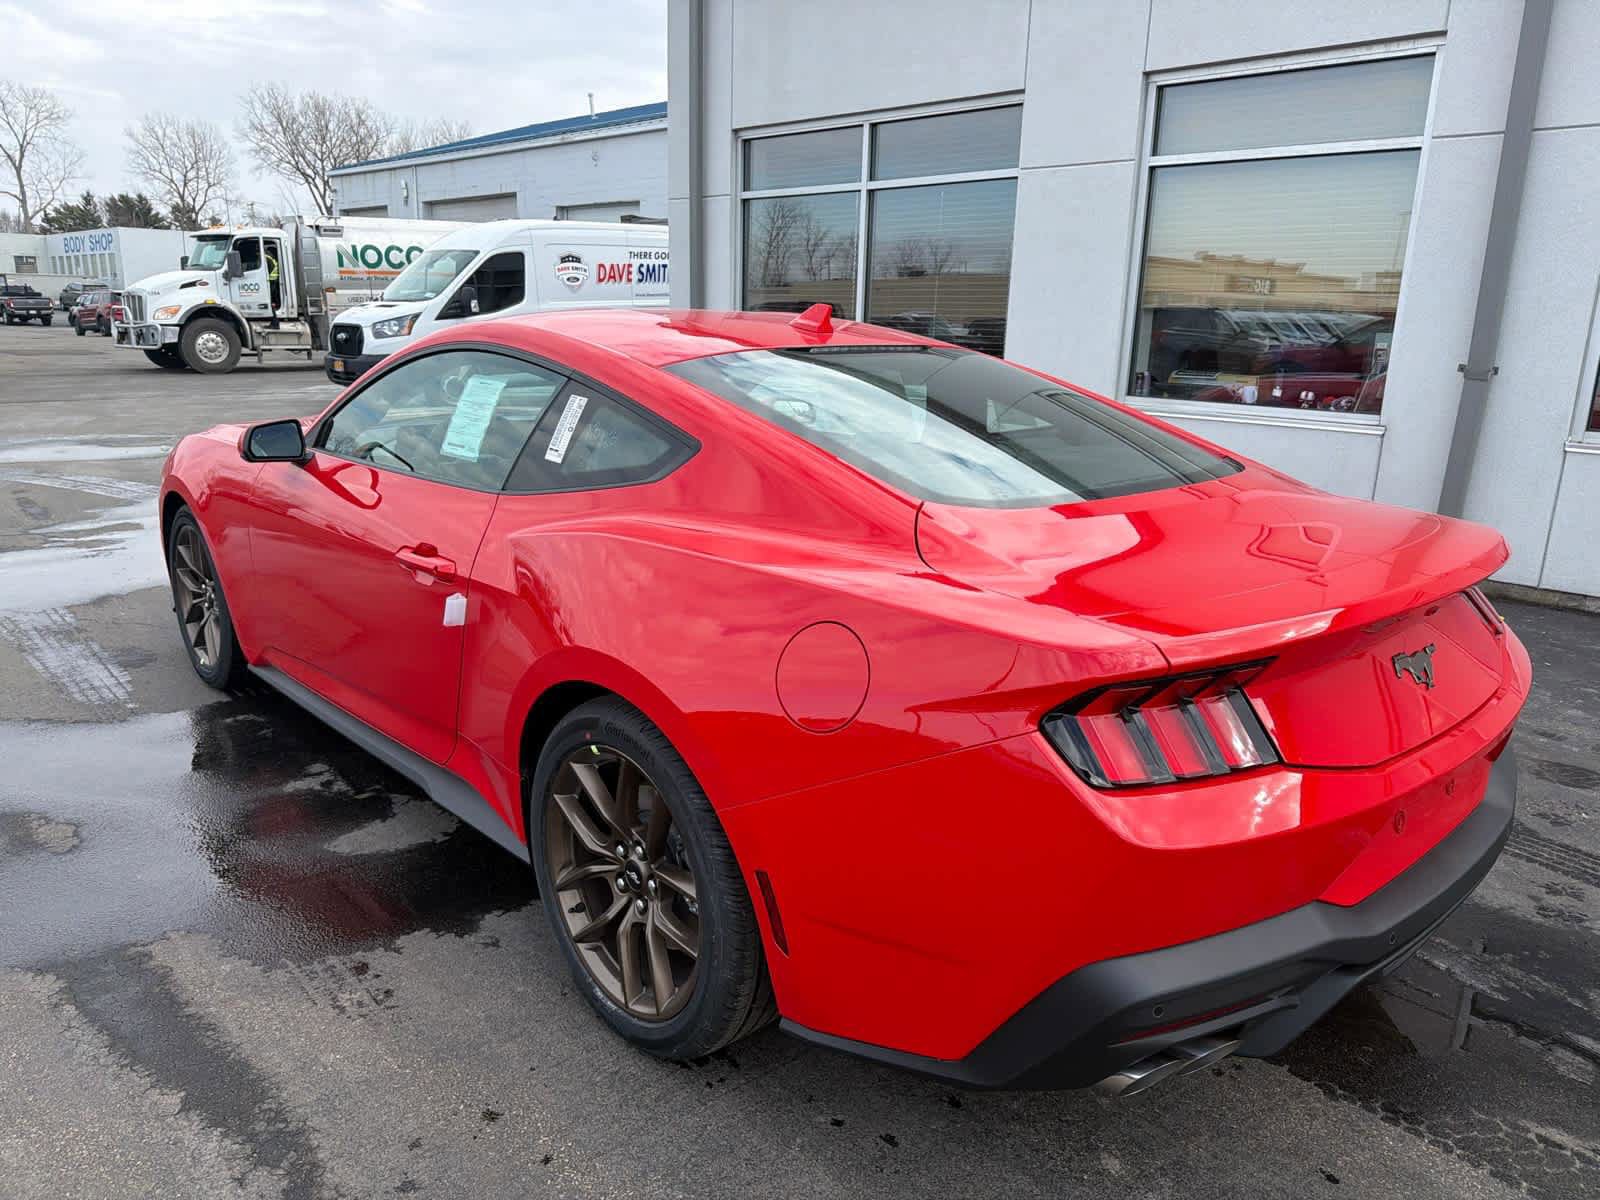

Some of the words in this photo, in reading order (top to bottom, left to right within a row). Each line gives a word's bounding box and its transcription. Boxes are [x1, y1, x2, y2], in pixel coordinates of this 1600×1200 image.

[64, 235, 85, 253] BODY
[89, 232, 113, 251] SHOP
[629, 251, 652, 260] THERE
[597, 263, 633, 283] DAVE
[637, 263, 669, 283] SMIT
